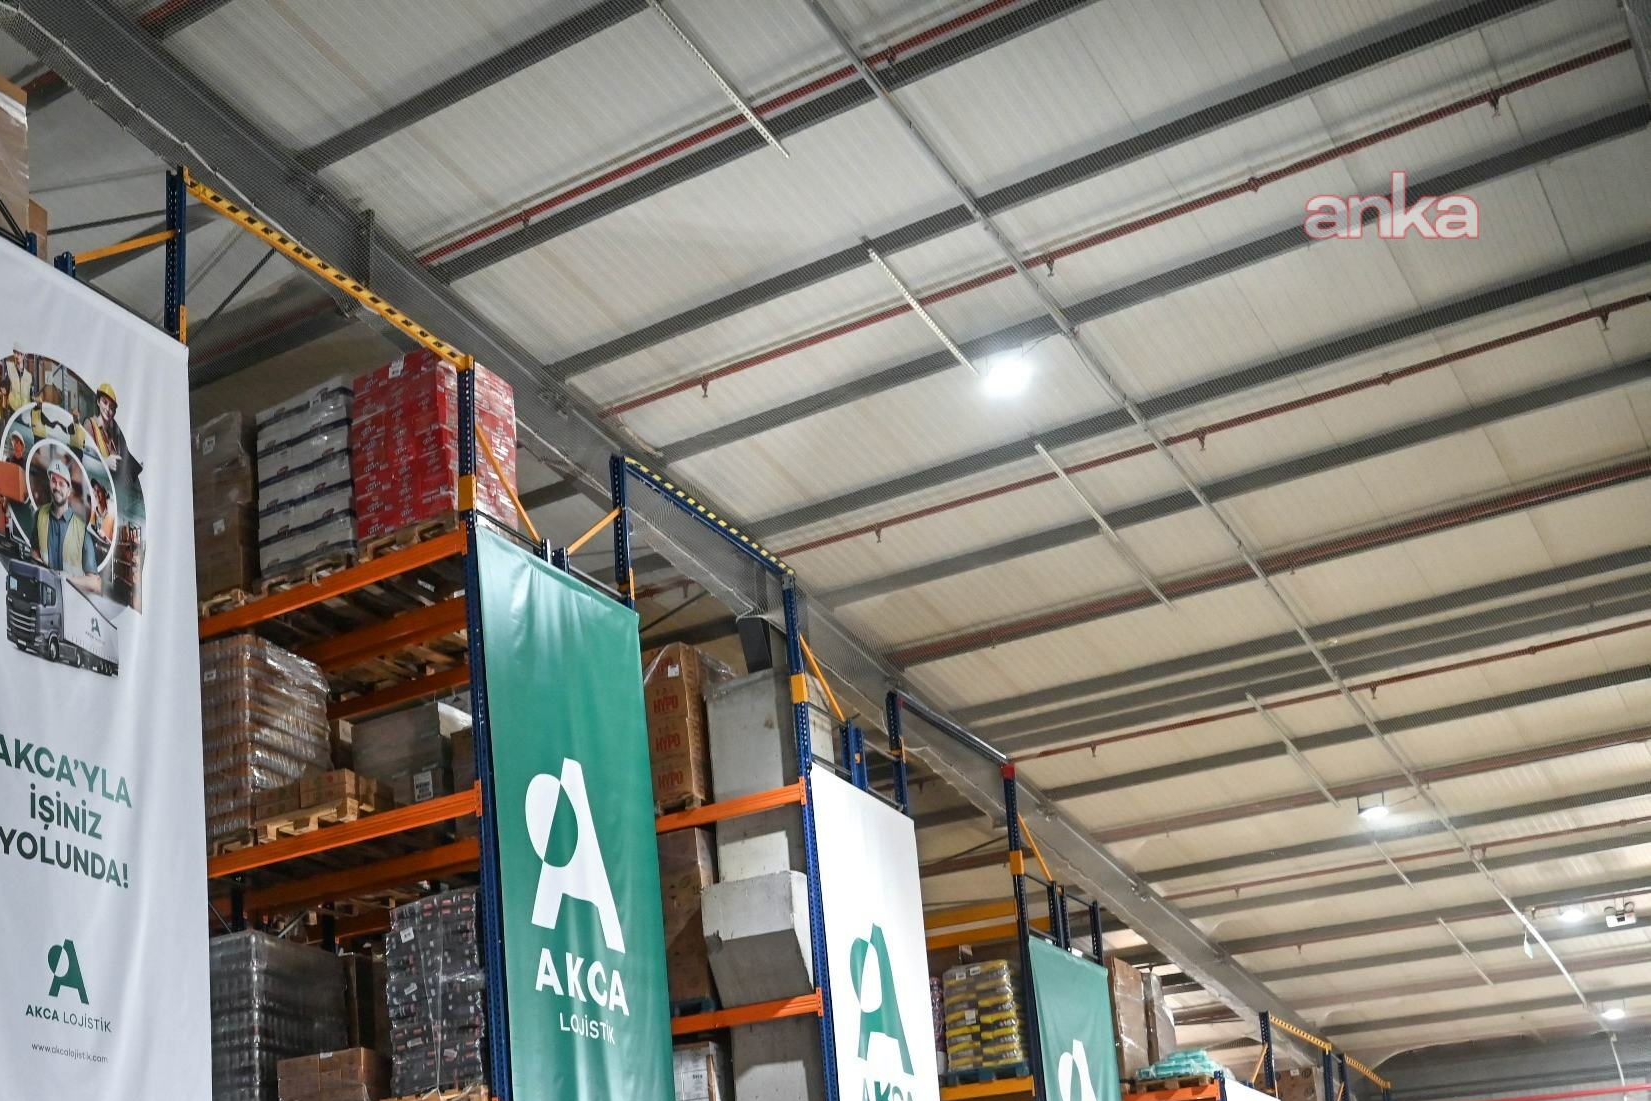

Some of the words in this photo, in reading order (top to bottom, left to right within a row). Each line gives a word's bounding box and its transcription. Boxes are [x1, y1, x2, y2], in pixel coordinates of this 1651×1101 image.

[29, 783, 102, 840] İŞİNİZ
[535, 947, 630, 1017] AKCA
[25, 1004, 60, 1022] AKCA
[63, 1011, 112, 1033] LOJİSTİK
[559, 1012, 616, 1045] LOJİSTİK
